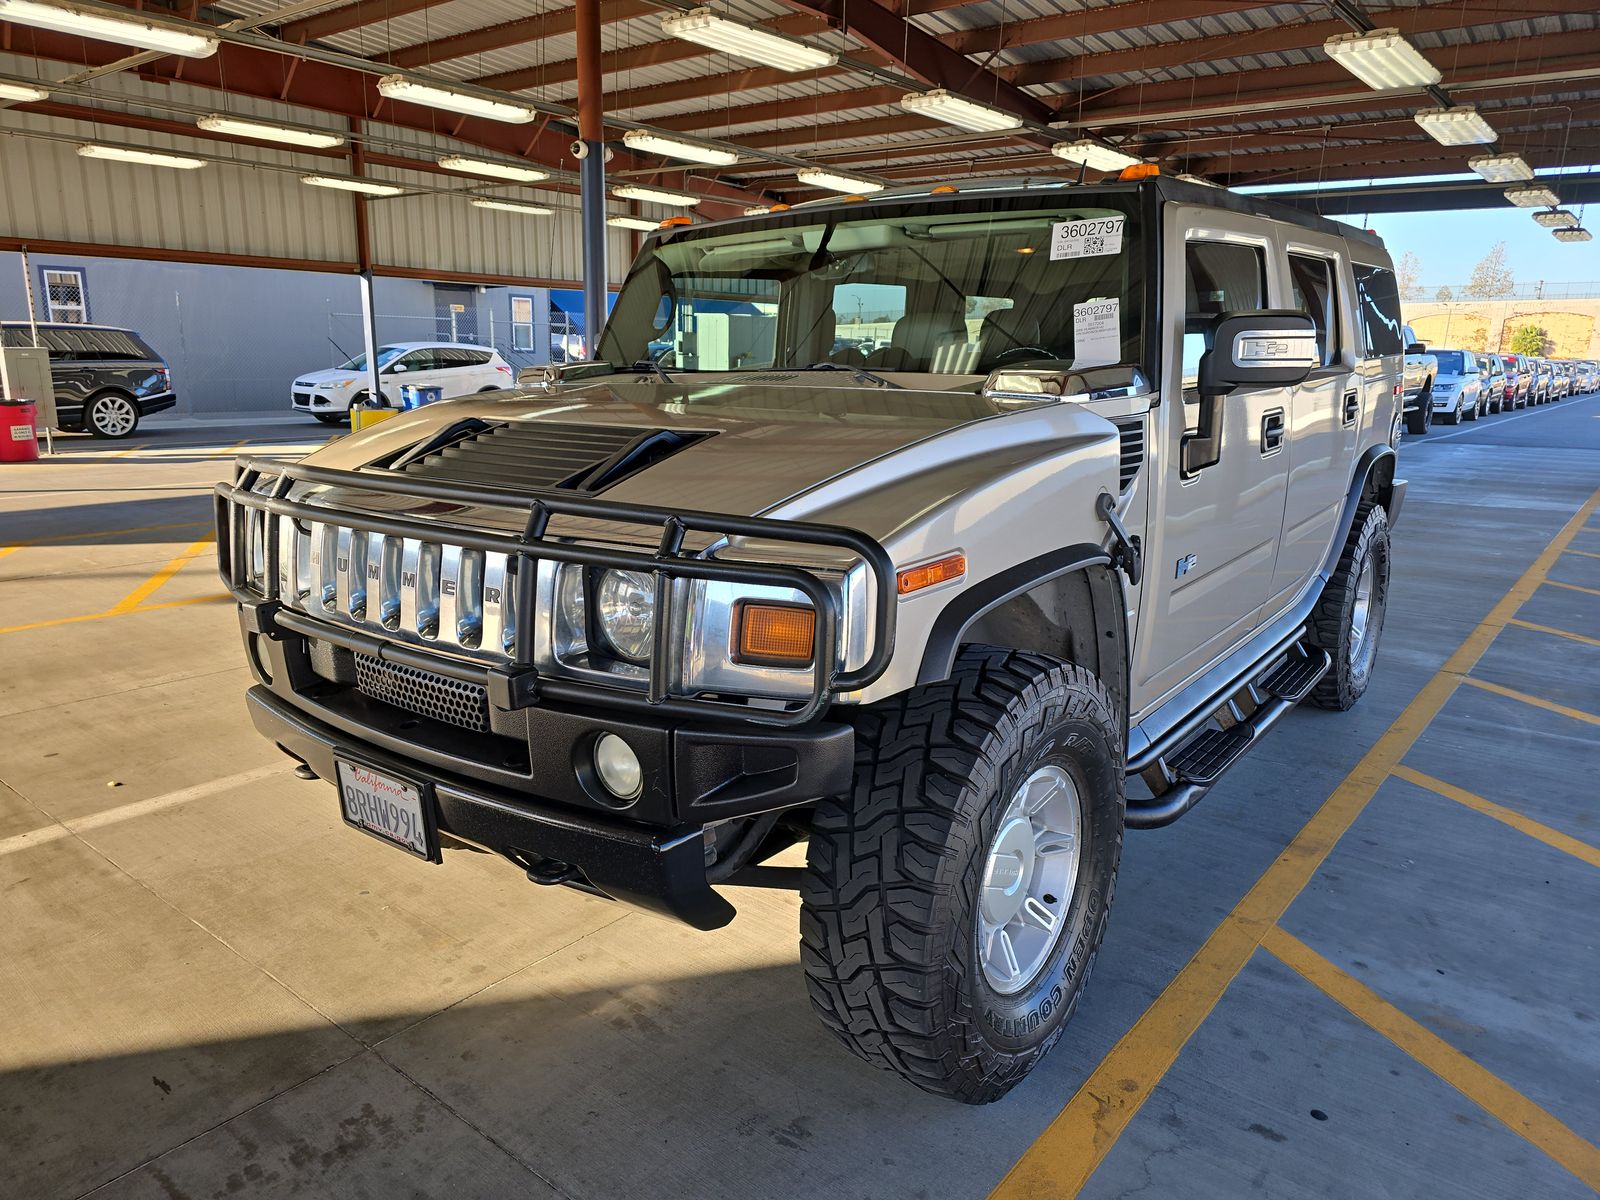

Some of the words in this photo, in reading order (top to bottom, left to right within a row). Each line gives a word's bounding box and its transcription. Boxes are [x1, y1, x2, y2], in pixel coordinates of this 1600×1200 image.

[1061, 220, 1123, 238] 3602797
[1074, 303, 1119, 317] 3602797
[311, 551, 501, 604] HUMMER
[353, 768, 409, 801] California
